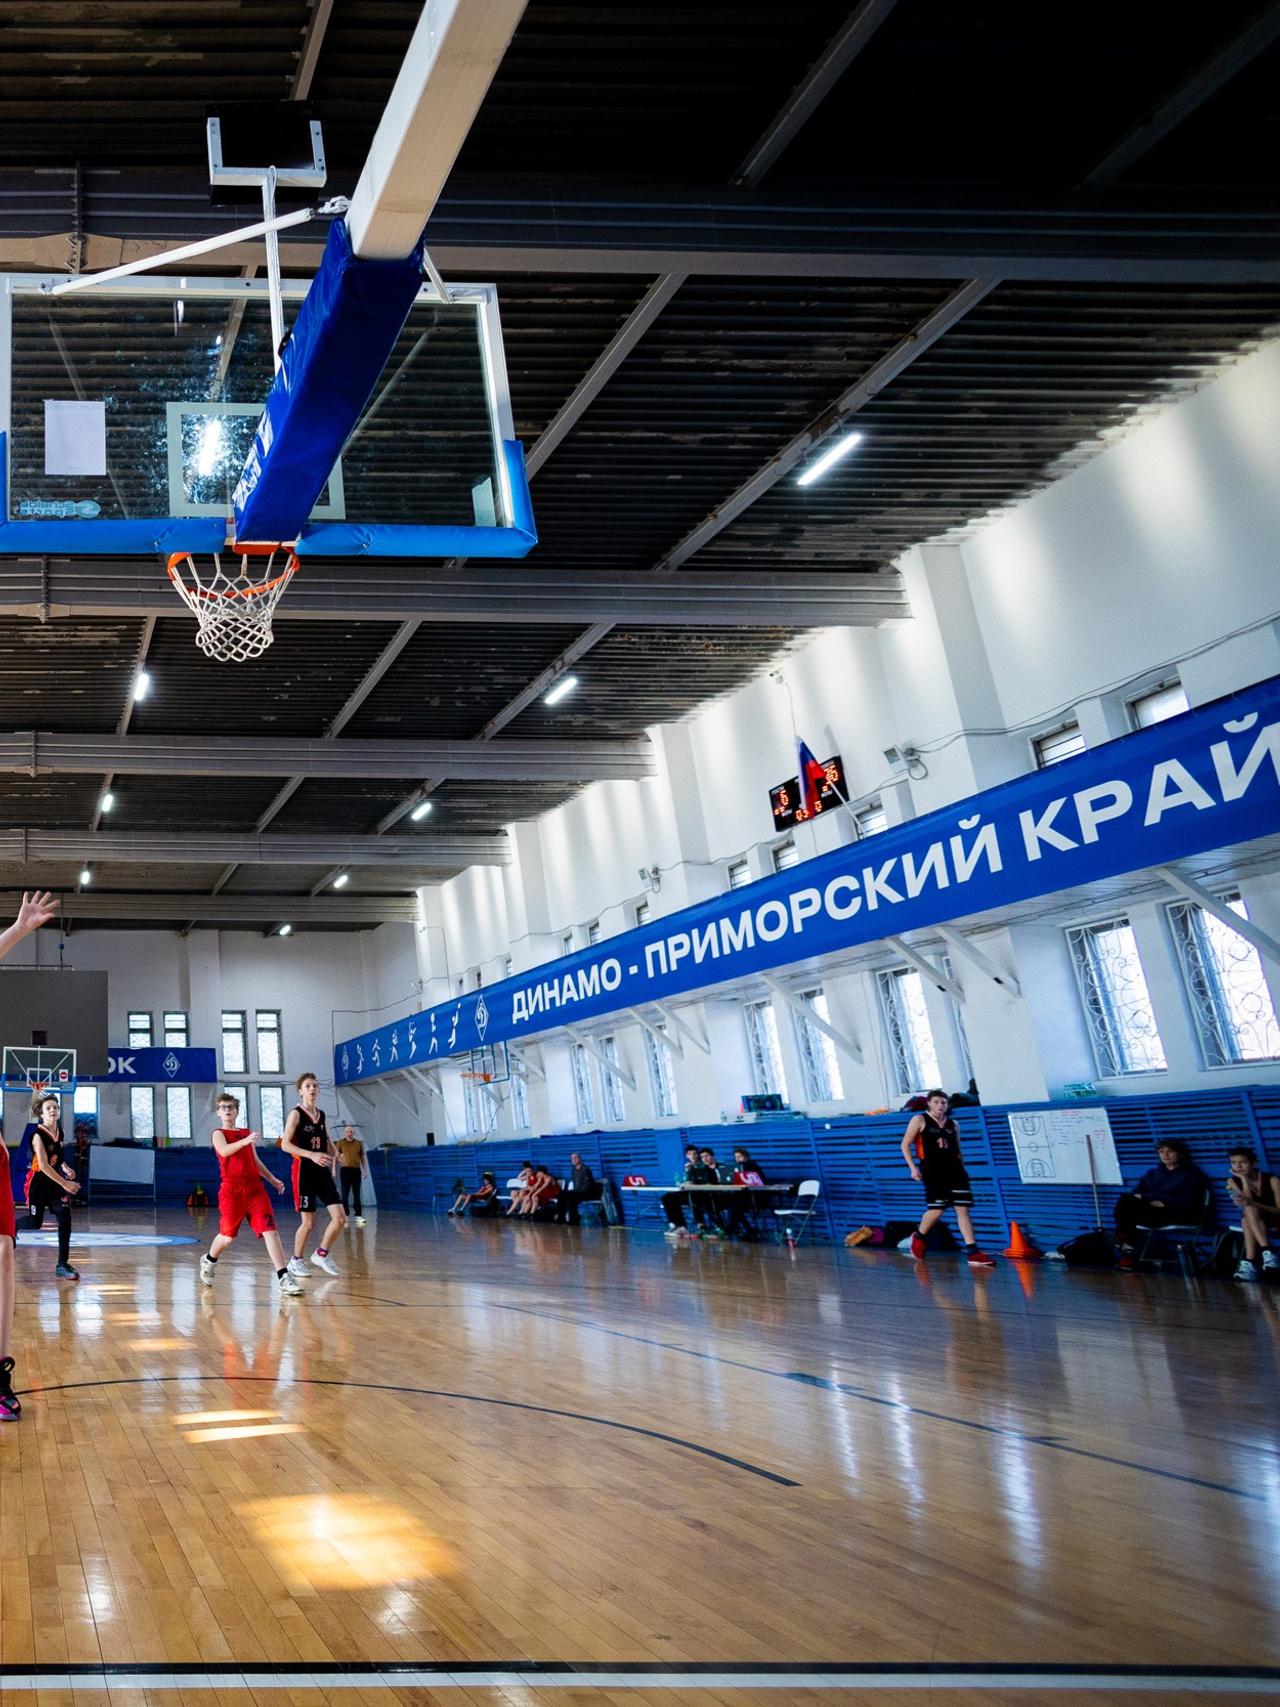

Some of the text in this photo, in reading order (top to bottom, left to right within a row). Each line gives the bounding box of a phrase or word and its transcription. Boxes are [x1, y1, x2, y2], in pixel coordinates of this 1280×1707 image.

[512, 958, 622, 1024] ДИНАМО
[644, 814, 1003, 978] ПРИМОРСКИЙ
[1018, 711, 1280, 862] КРАЙ
[310, 1136, 321, 1149] 13
